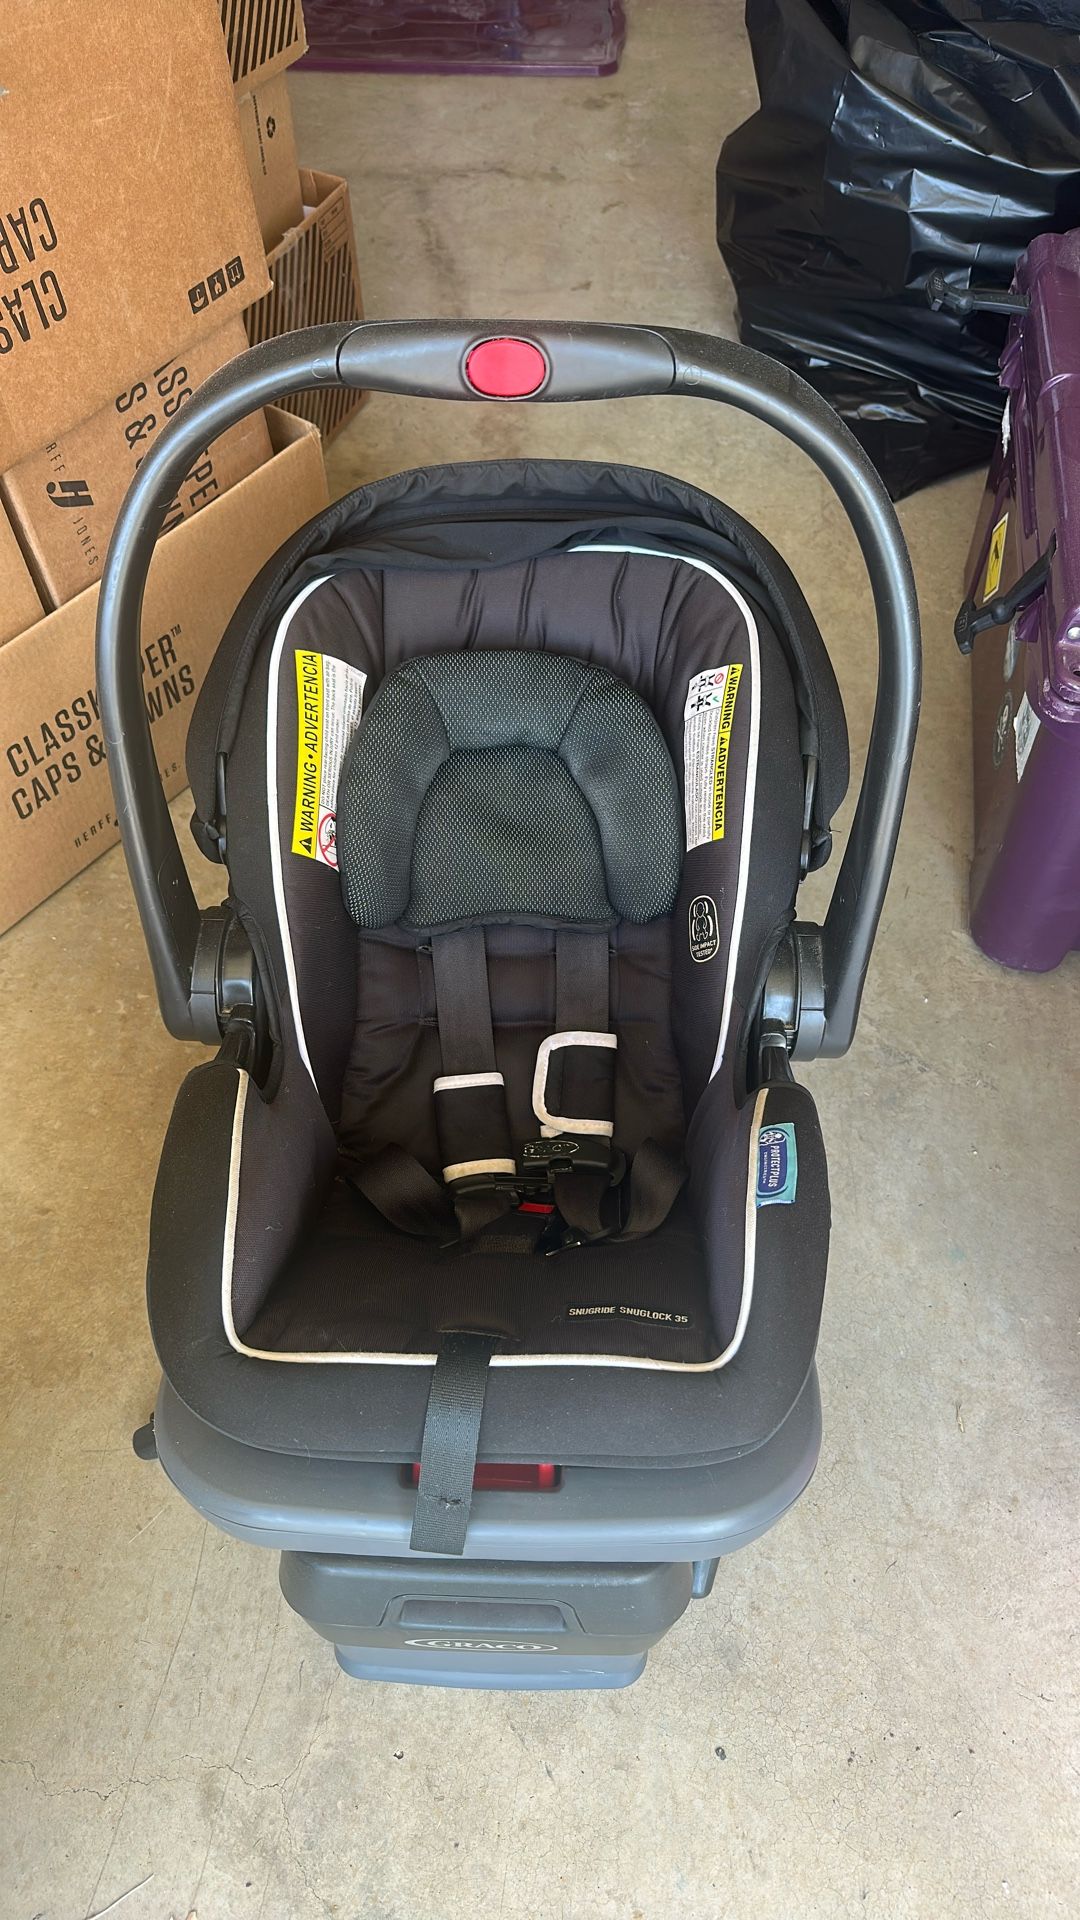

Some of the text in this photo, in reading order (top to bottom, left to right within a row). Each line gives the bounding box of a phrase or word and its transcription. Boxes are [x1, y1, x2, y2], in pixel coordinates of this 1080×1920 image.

[45, 442, 66, 472] RFF
[73, 517, 99, 566] JONES
[721, 676, 738, 730] WARNING
[300, 654, 318, 832] WARNING ADVERTENCIA
[10, 751, 82, 820] CAPS
[86, 734, 107, 767] &
[714, 747, 727, 832] ADVERTENCIA
[74, 812, 111, 848] HERFF
[768, 1145, 781, 1187] PROTECTPLUS
[568, 1306, 689, 1323] SNUGRIDE SNUGLOCK 35
[427, 1640, 542, 1650] GRACO
